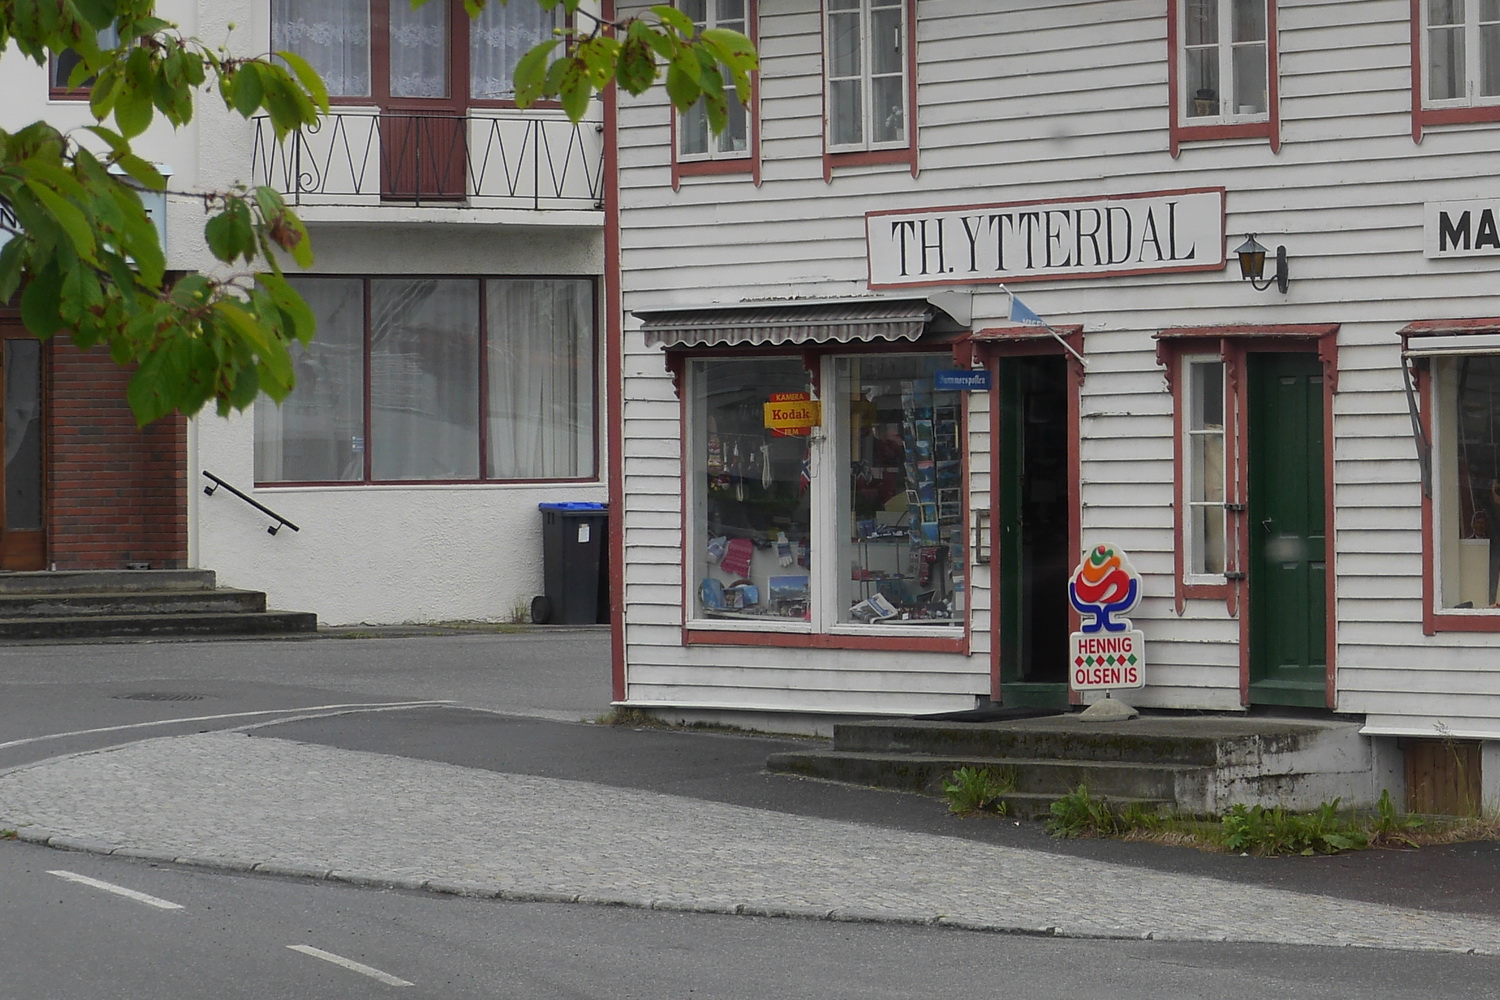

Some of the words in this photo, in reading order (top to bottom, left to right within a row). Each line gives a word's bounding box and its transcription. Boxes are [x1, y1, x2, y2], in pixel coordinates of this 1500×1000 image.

[772, 408, 810, 420] Kodak
[1078, 637, 1132, 654] HENNIG
[1075, 667, 1120, 684] OLSEN
[1124, 667, 1138, 683] IS
